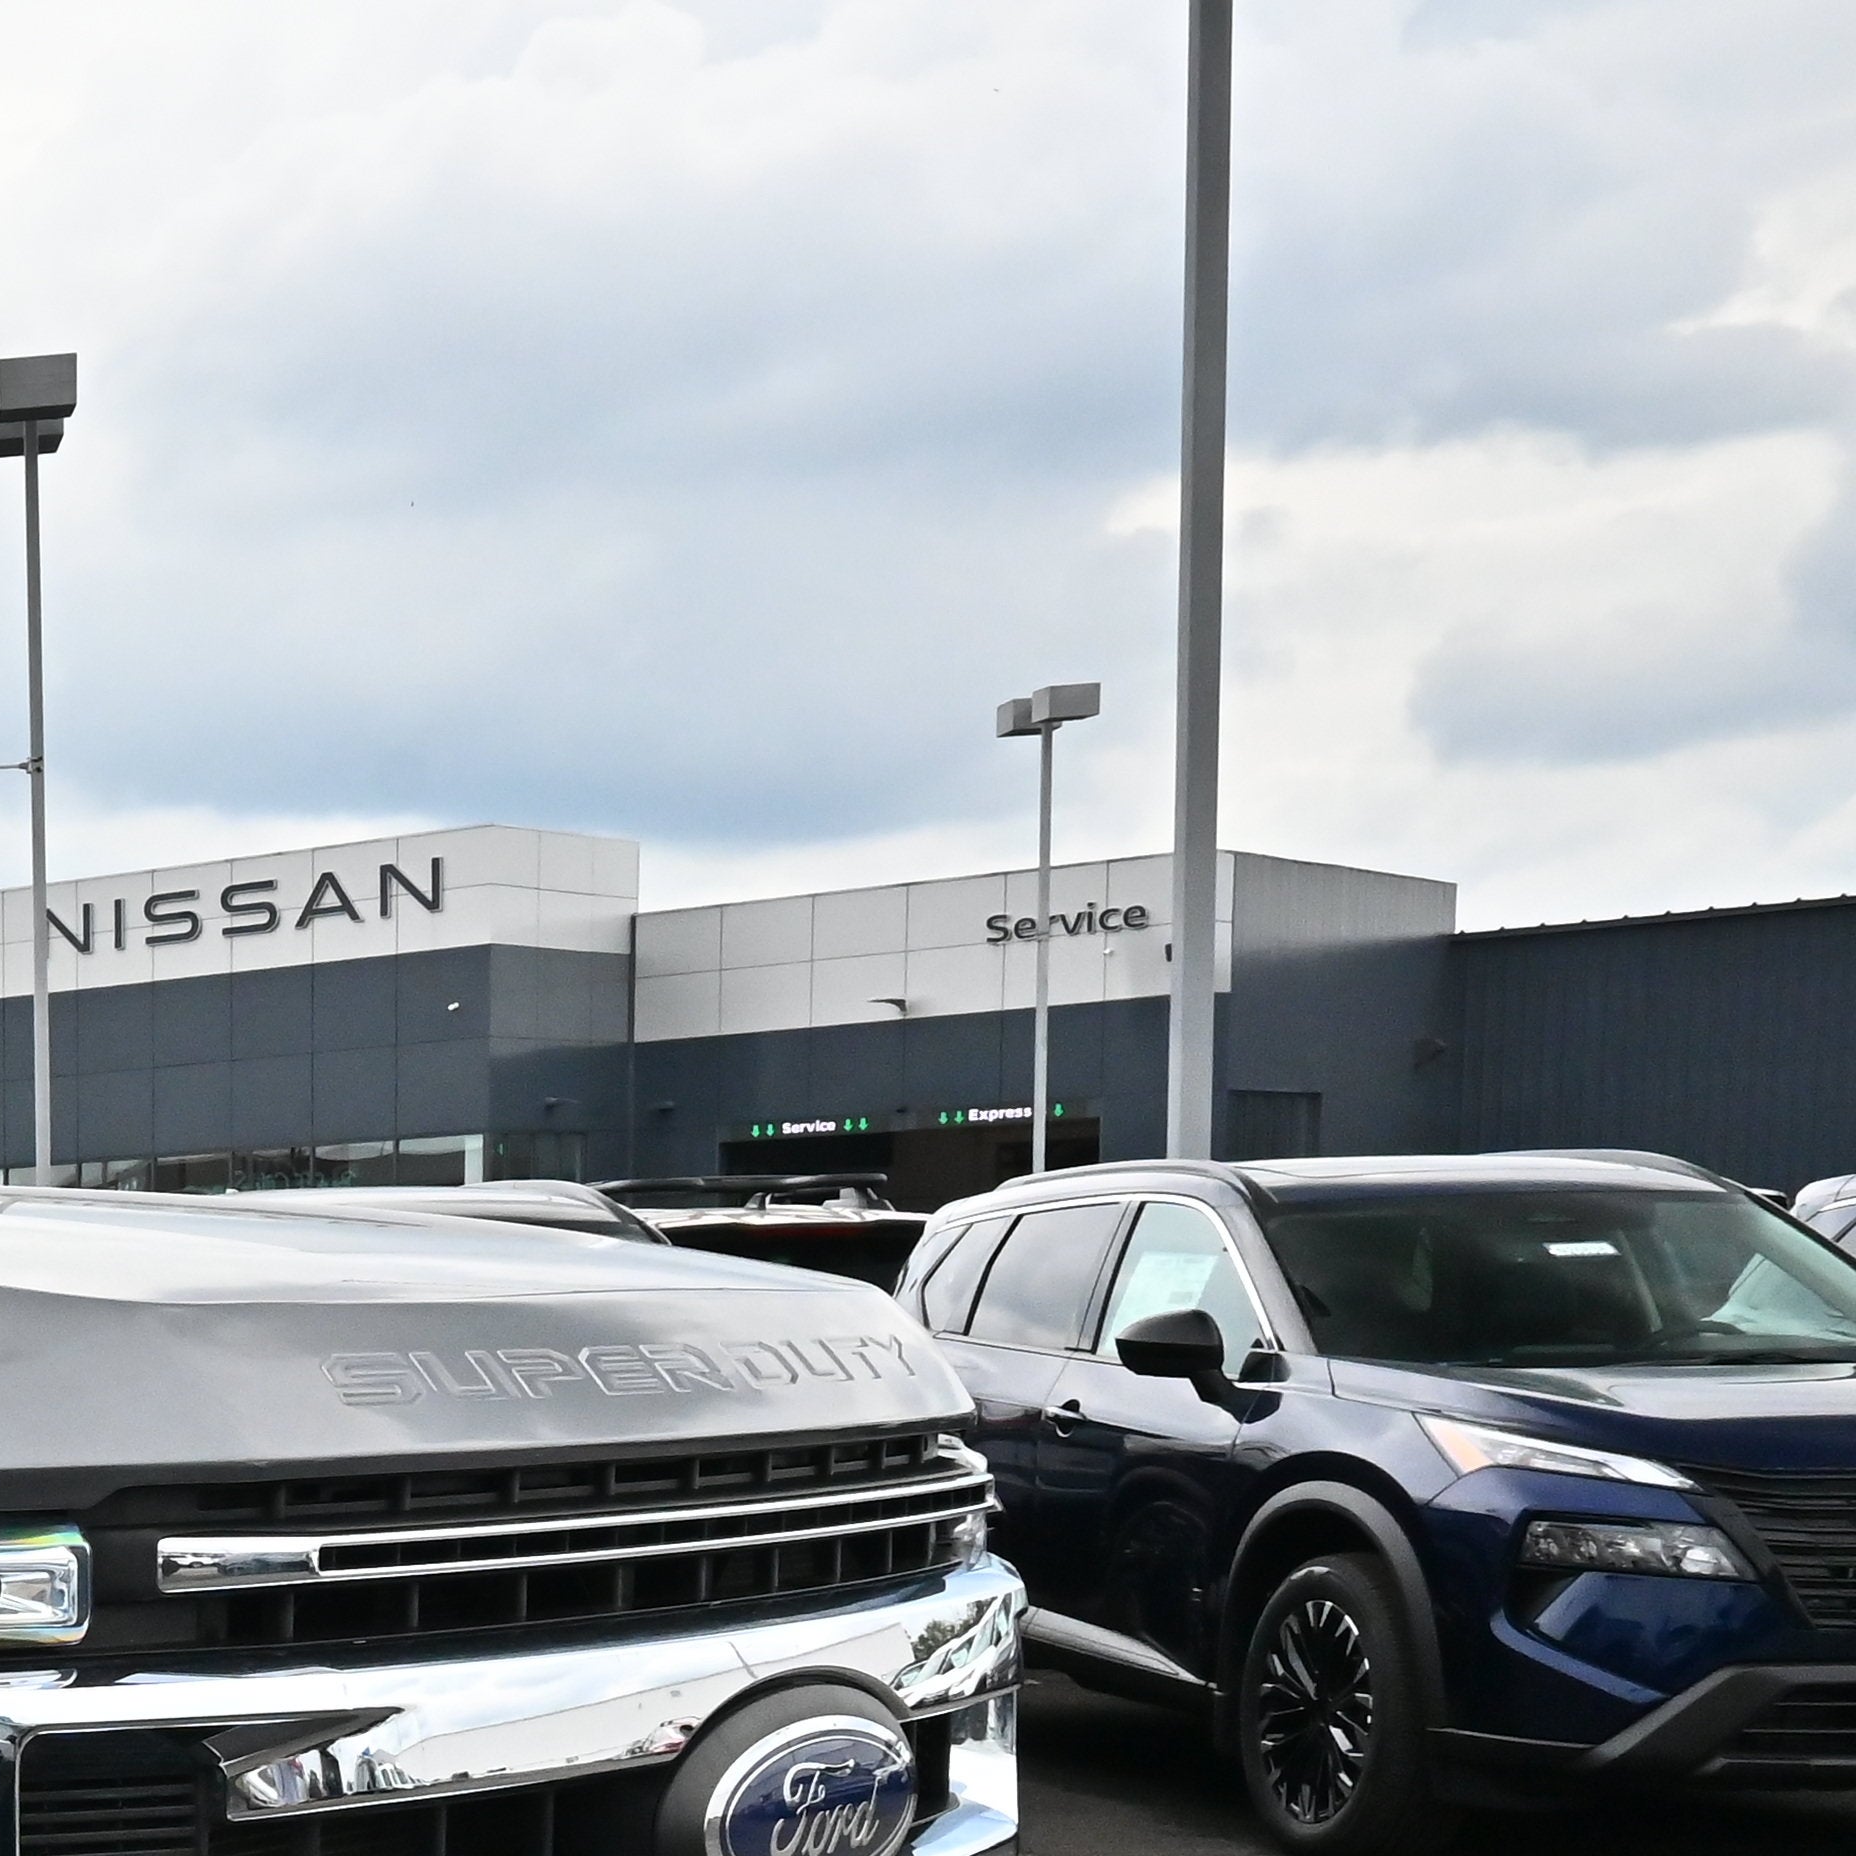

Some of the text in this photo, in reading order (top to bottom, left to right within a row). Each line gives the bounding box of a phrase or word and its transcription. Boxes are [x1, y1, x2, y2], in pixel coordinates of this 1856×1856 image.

[46, 857, 444, 955] NISSAN
[782, 1119, 837, 1134] Service
[968, 1107, 1033, 1122] Express
[320, 1334, 917, 1406] SUPER DUTY
